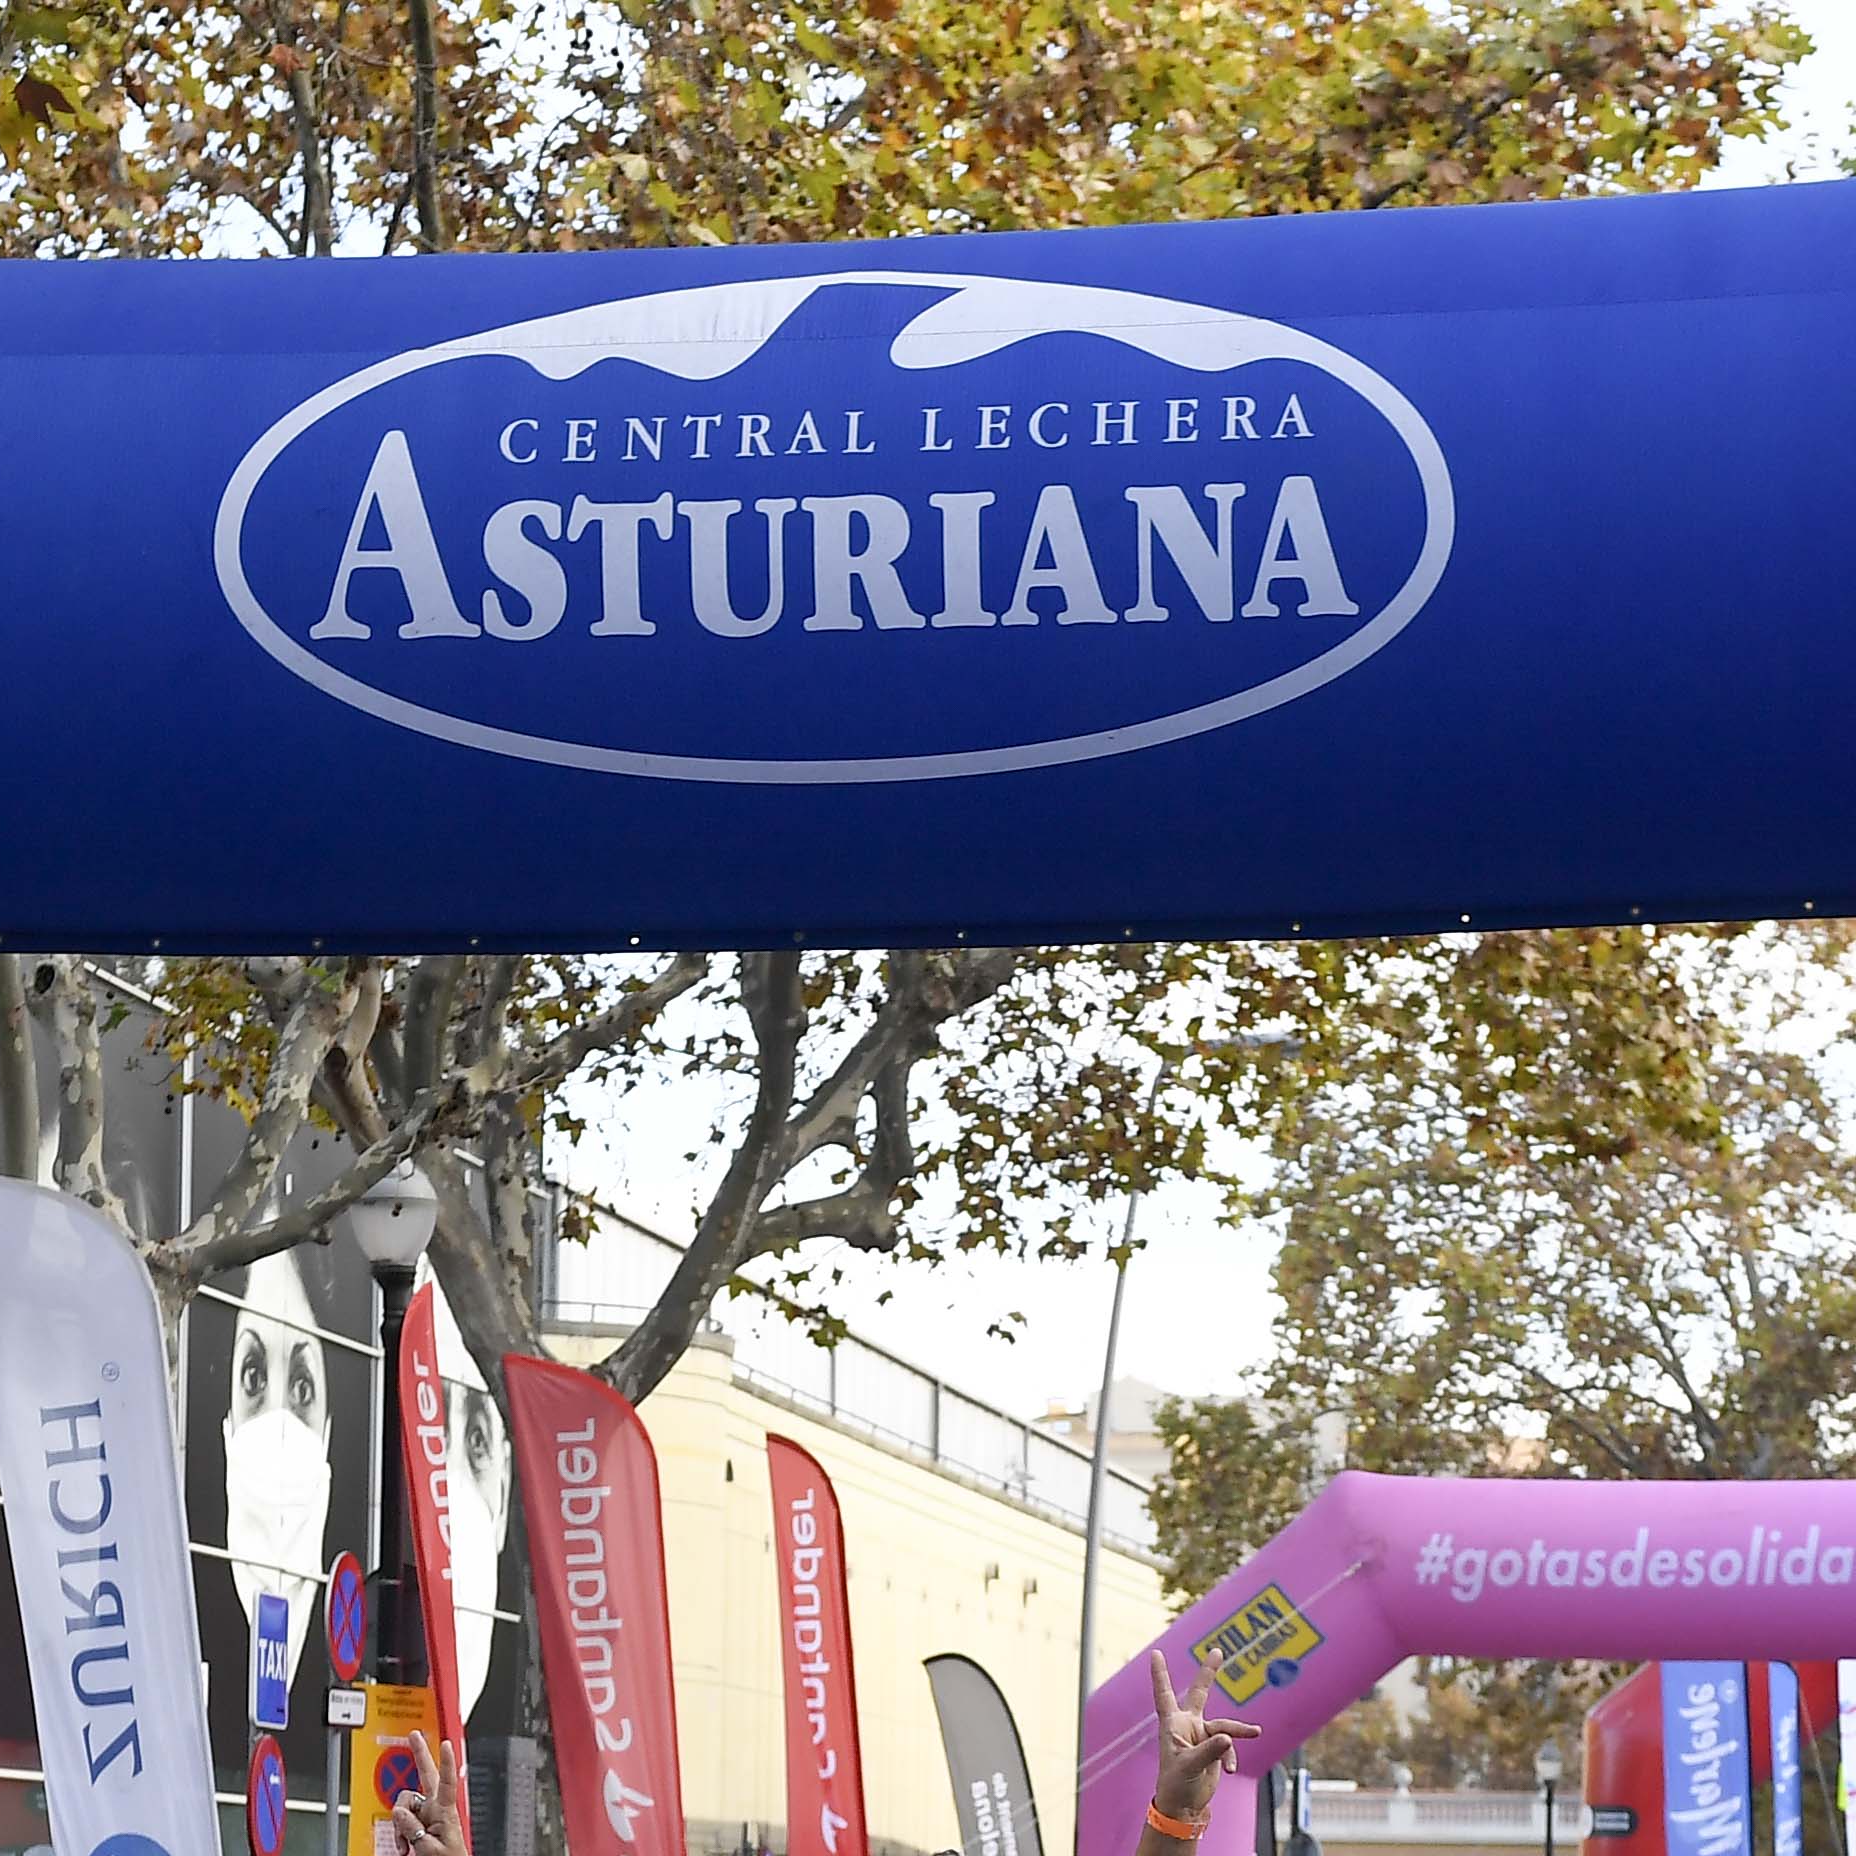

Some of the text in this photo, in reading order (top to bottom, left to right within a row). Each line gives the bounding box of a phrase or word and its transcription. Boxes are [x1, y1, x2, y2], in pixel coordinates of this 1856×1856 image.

[500, 392, 1315, 466] CENTRAL LECHERA
[309, 429, 1360, 643] ASTURIANA
[258, 1638, 287, 1682] TAXI
